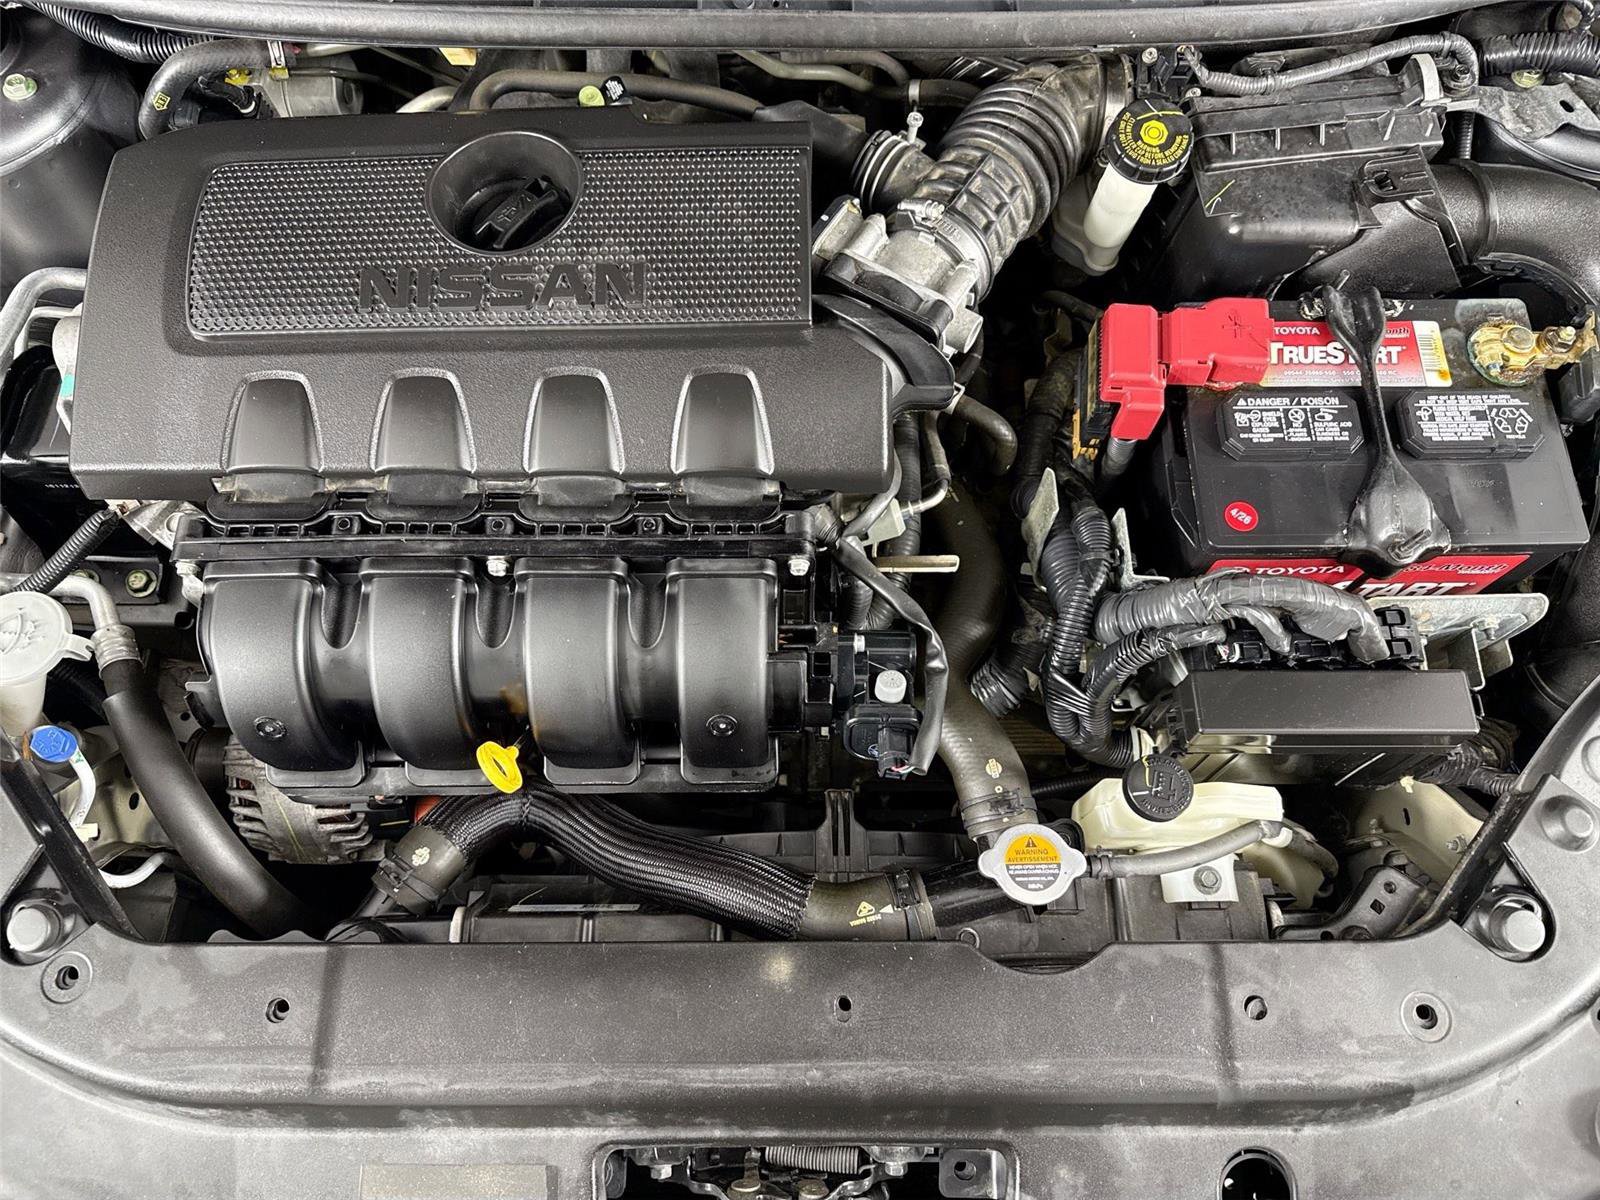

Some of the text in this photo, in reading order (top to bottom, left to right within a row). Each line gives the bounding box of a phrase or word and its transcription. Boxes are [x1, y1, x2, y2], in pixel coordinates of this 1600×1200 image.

[1134, 147, 1145, 155] CAP
[1137, 140, 1160, 152] WARNING
[359, 263, 647, 308] NISSAN
[1274, 327, 1320, 335] TOYOTA
[1270, 342, 1401, 364] TRUESRT
[1247, 396, 1340, 406] DANGER / POISON
[1230, 508, 1252, 525] 4/26
[1256, 566, 1345, 574] TOYOTA
